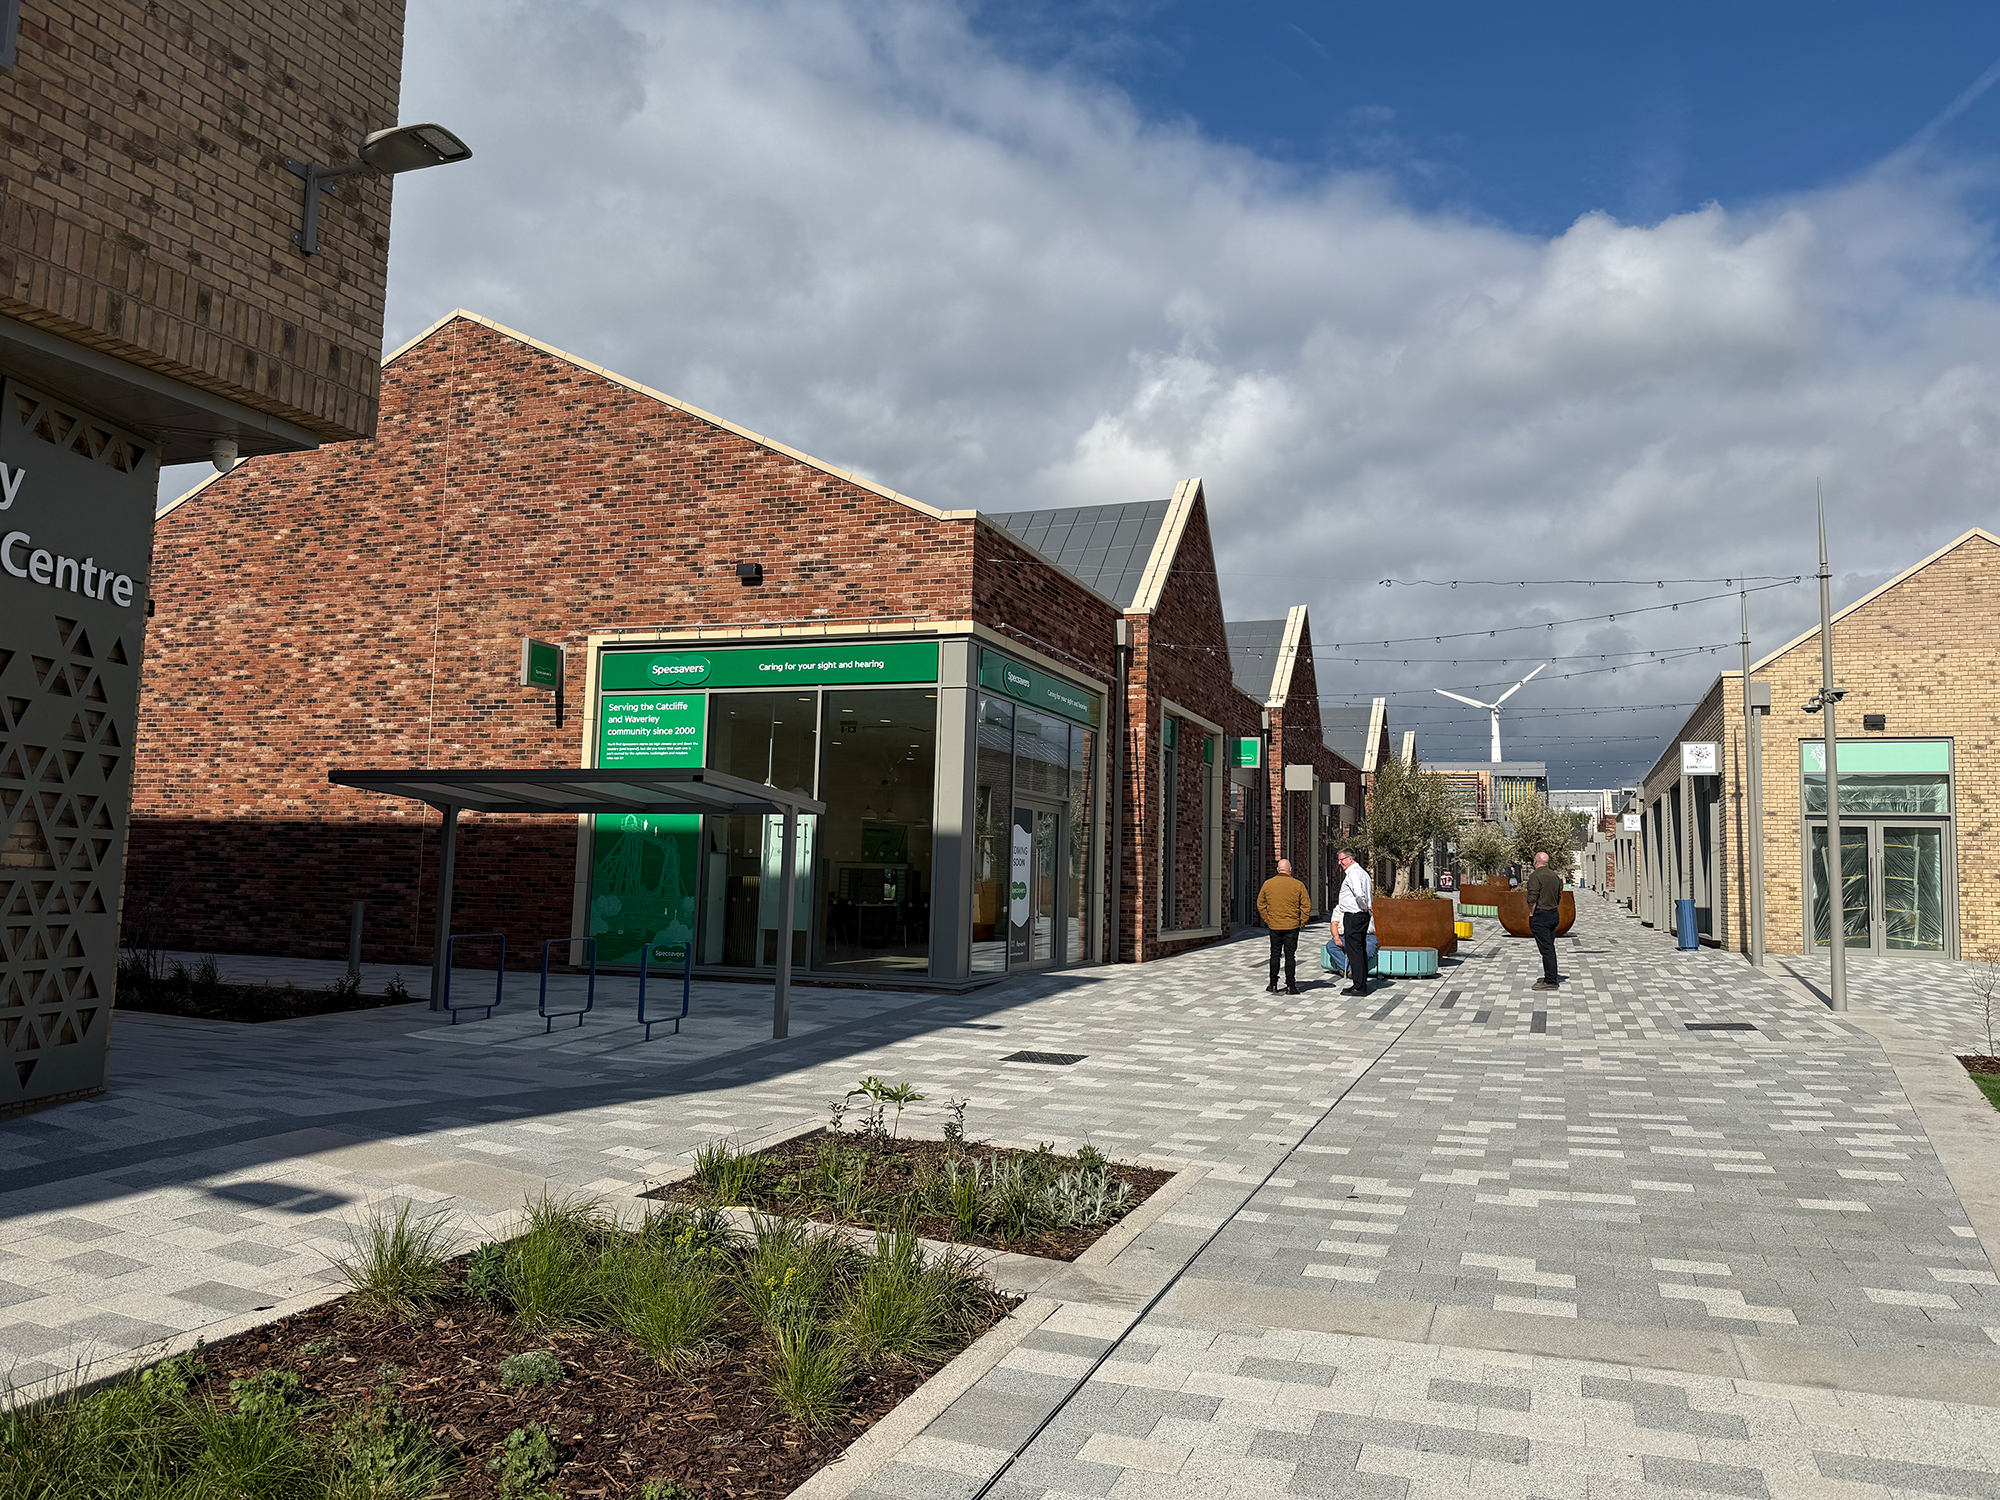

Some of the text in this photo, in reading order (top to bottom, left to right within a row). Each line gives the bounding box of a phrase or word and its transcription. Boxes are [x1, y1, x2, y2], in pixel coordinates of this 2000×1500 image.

[1, 530, 134, 608] Centre
[652, 664, 705, 676] Specsavers
[759, 663, 783, 673] Caring
[785, 662, 796, 671] for
[798, 663, 816, 672] your
[817, 661, 837, 670] sight
[854, 660, 884, 670] hearing
[608, 702, 688, 713] Serving the Catcliffe
[608, 715, 660, 725] and Waverley
[607, 727, 696, 737] community since 2000
[1013, 846, 1029, 856] OMING
[655, 950, 685, 958] Specsavers
